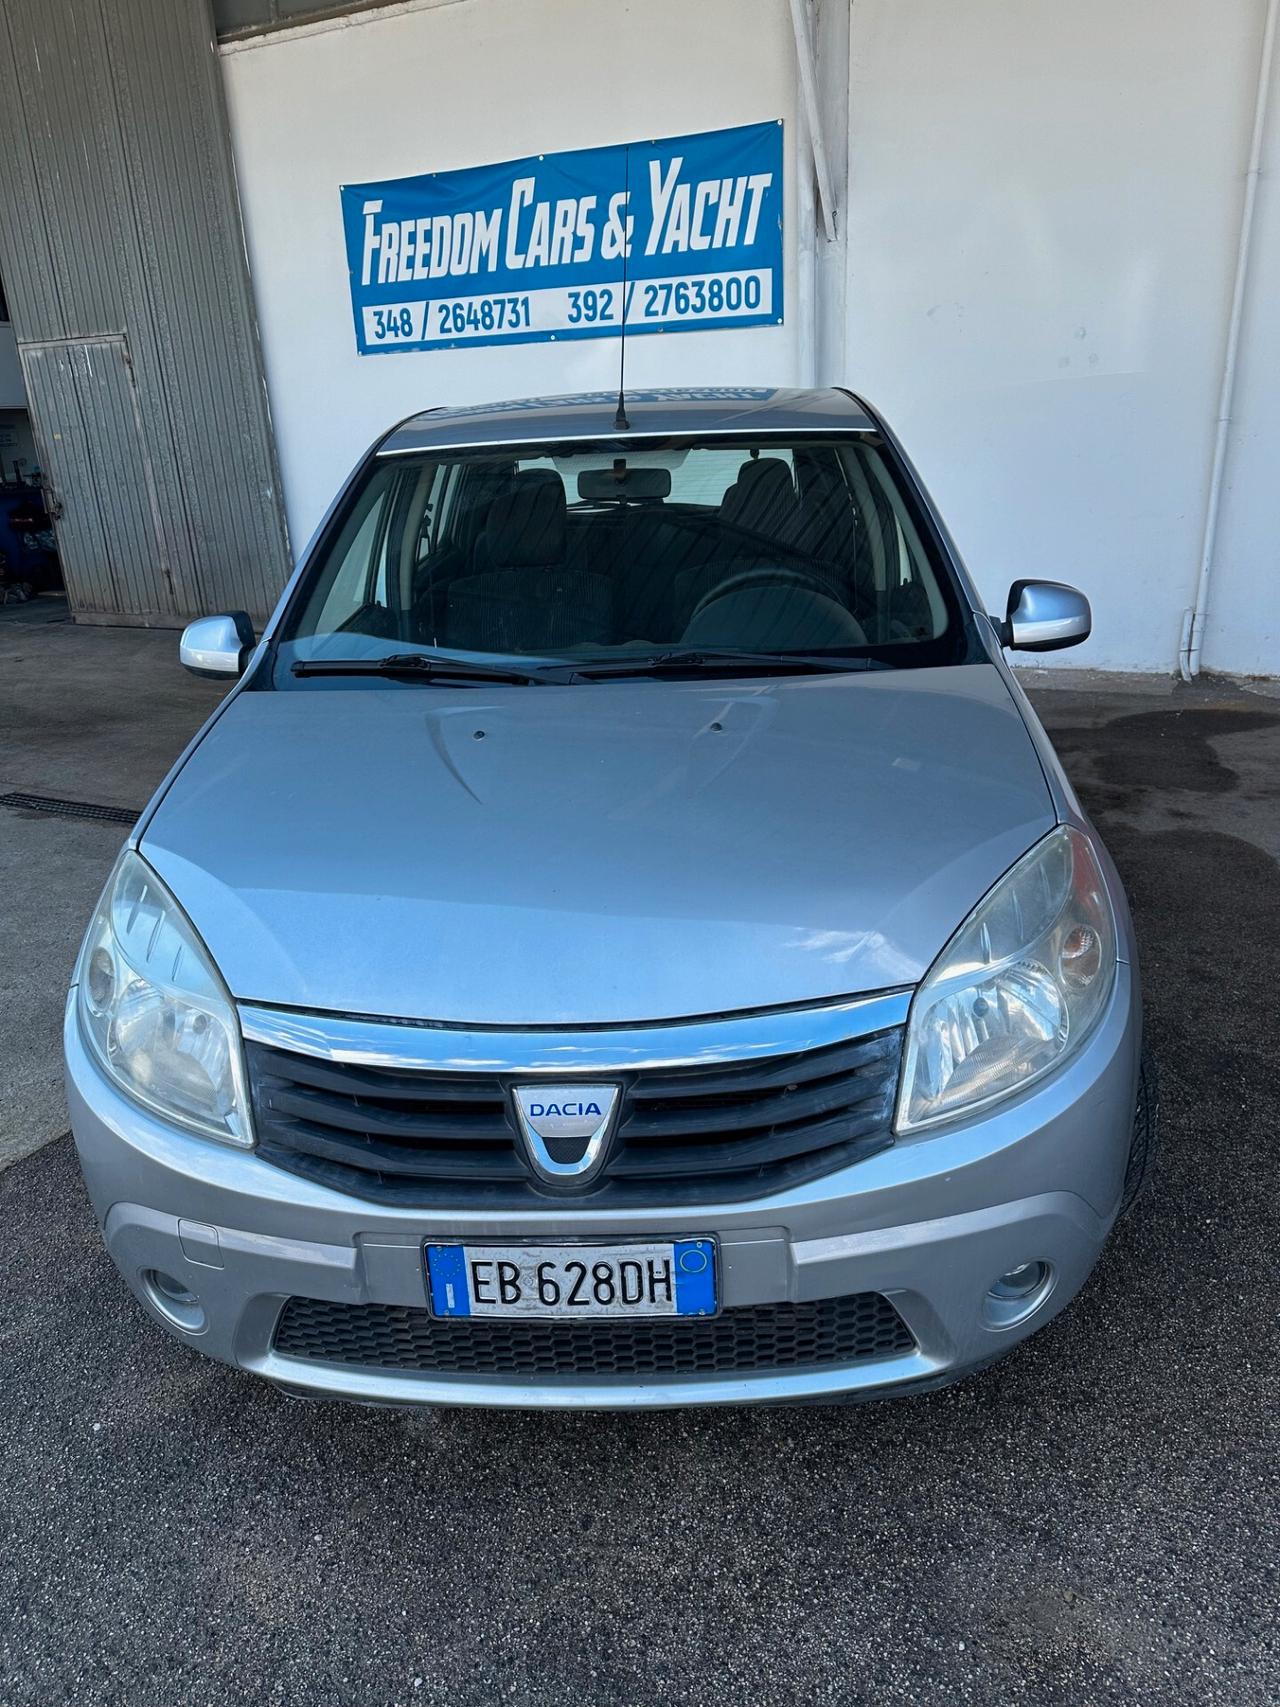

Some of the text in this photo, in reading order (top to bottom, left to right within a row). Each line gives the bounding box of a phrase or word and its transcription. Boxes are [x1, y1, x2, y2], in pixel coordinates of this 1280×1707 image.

[361, 157, 773, 286] FREEDOM CARS & YACHT
[373, 307, 413, 340] 348
[421, 301, 430, 340] /
[438, 296, 530, 334] 2648731
[567, 288, 614, 324] 392
[644, 275, 761, 317] 2763800
[530, 1103, 601, 1116] DACIA
